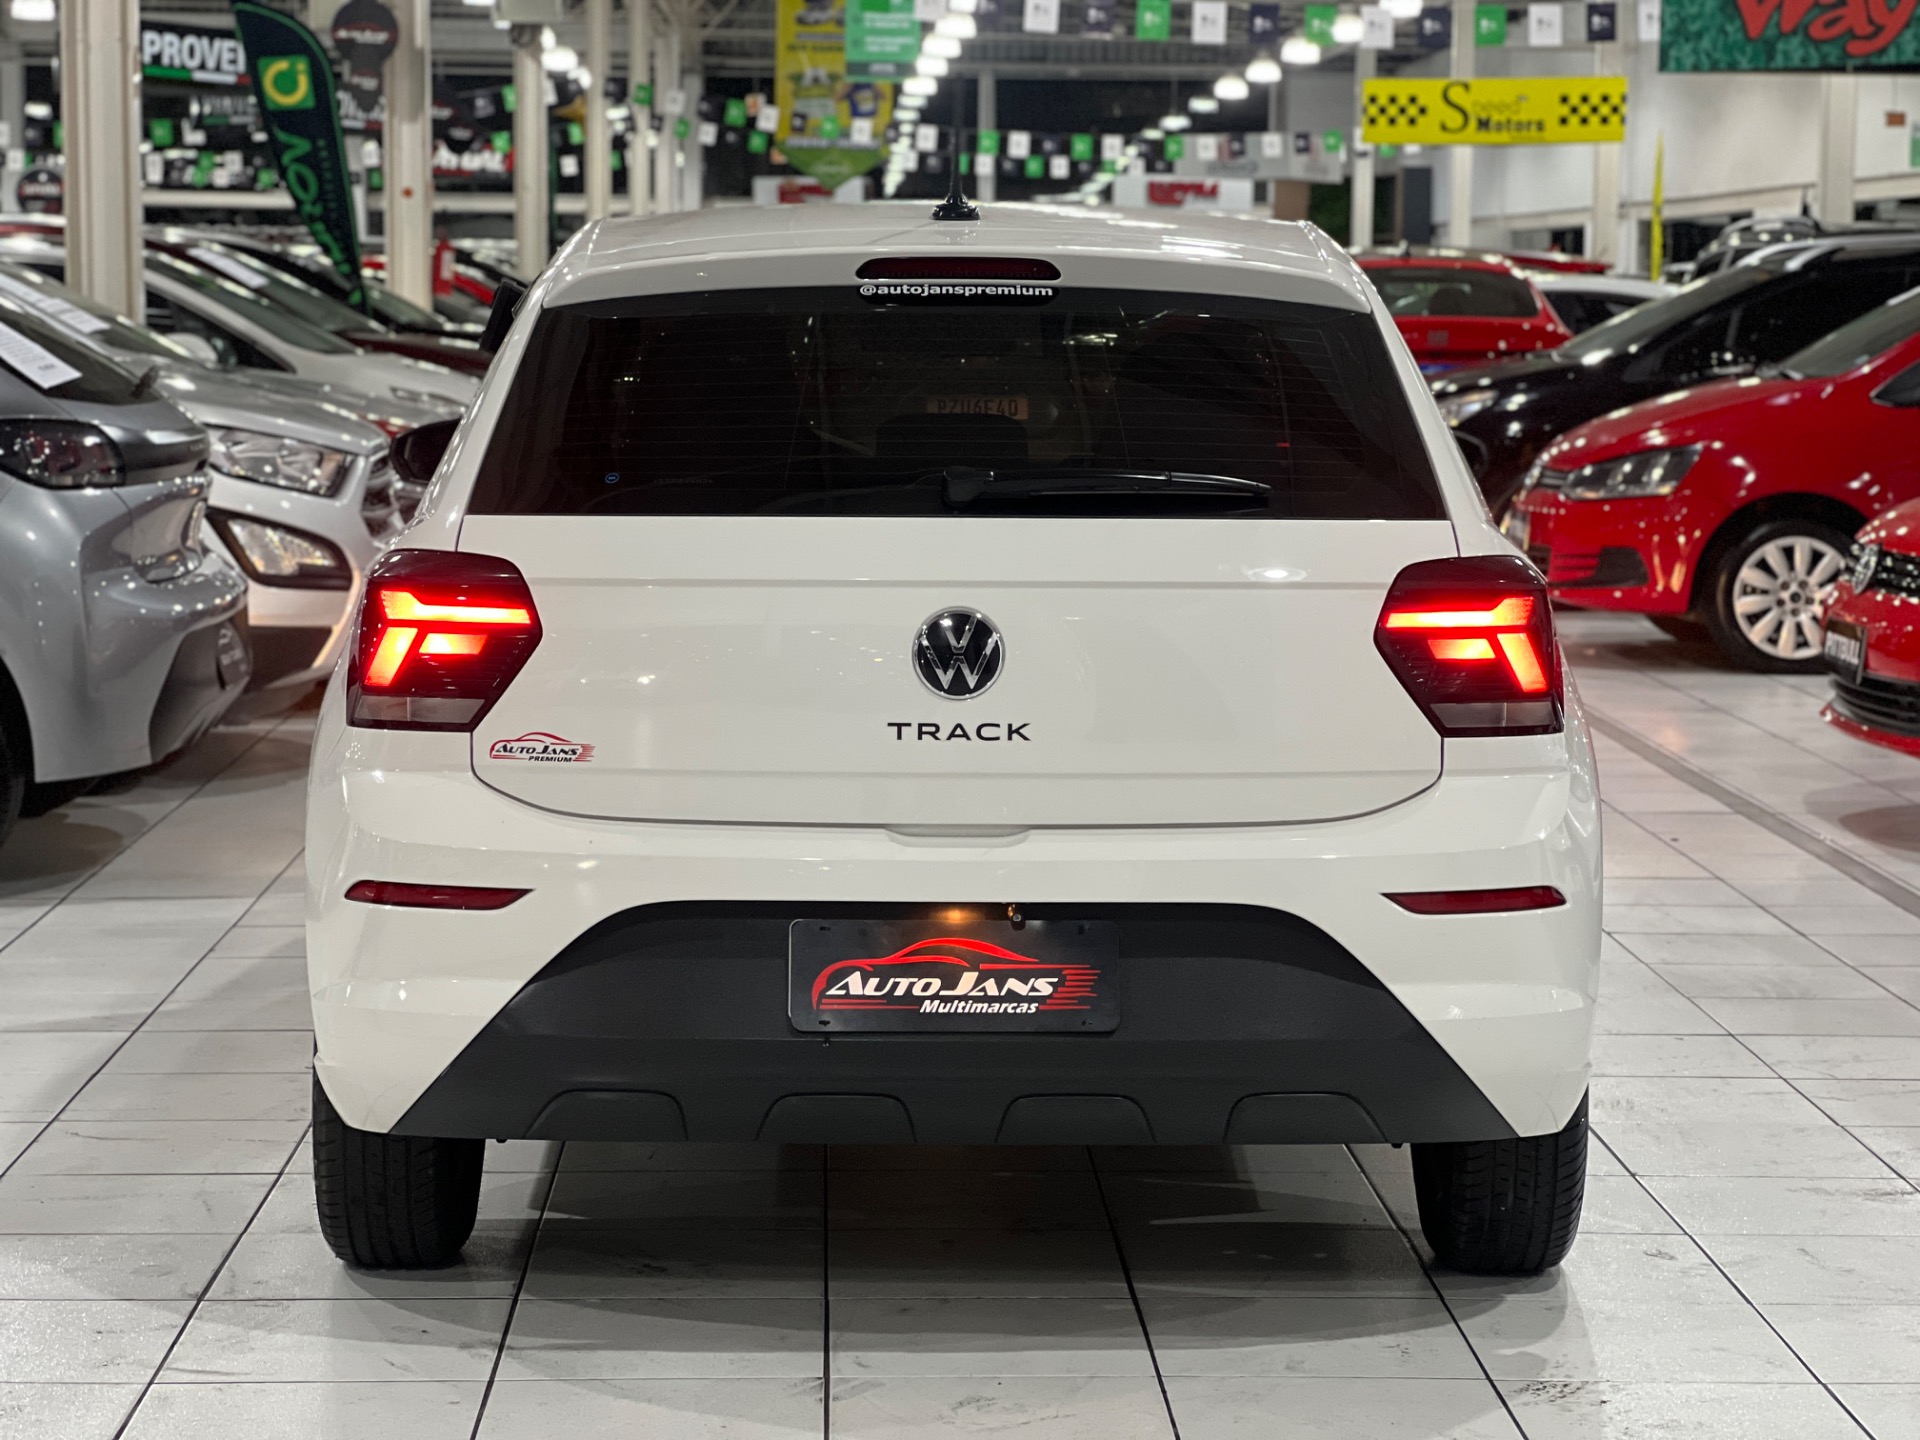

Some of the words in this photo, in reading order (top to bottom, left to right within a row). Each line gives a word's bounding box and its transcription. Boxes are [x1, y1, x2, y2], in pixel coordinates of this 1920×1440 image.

[142, 29, 247, 74] PROVE
[859, 284, 1053, 296] @autojanspremium
[887, 722, 1031, 742] TRACK
[528, 755, 572, 763] PREMIUM
[919, 999, 1039, 1014] Multimarcas
